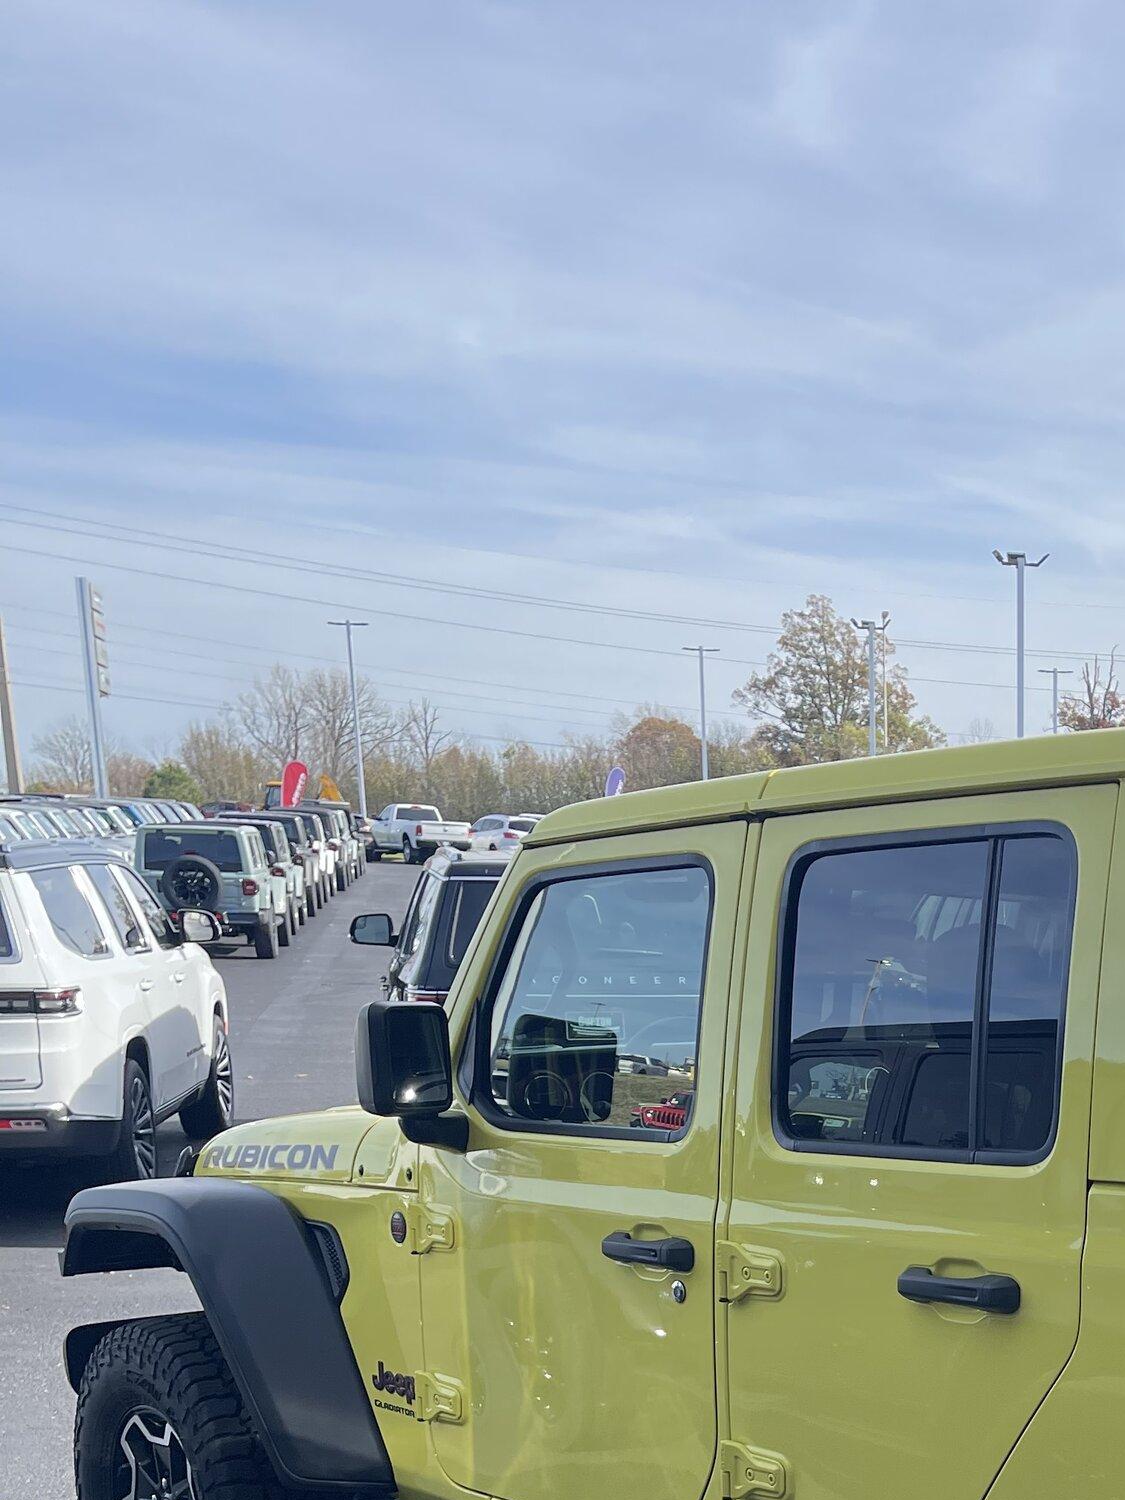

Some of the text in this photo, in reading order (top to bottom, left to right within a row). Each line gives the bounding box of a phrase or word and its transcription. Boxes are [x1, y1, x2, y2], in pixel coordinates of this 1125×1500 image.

[202, 1144, 340, 1170] RUBICON
[371, 1360, 416, 1406] Jeep
[374, 1399, 416, 1418] GLADIATOR
